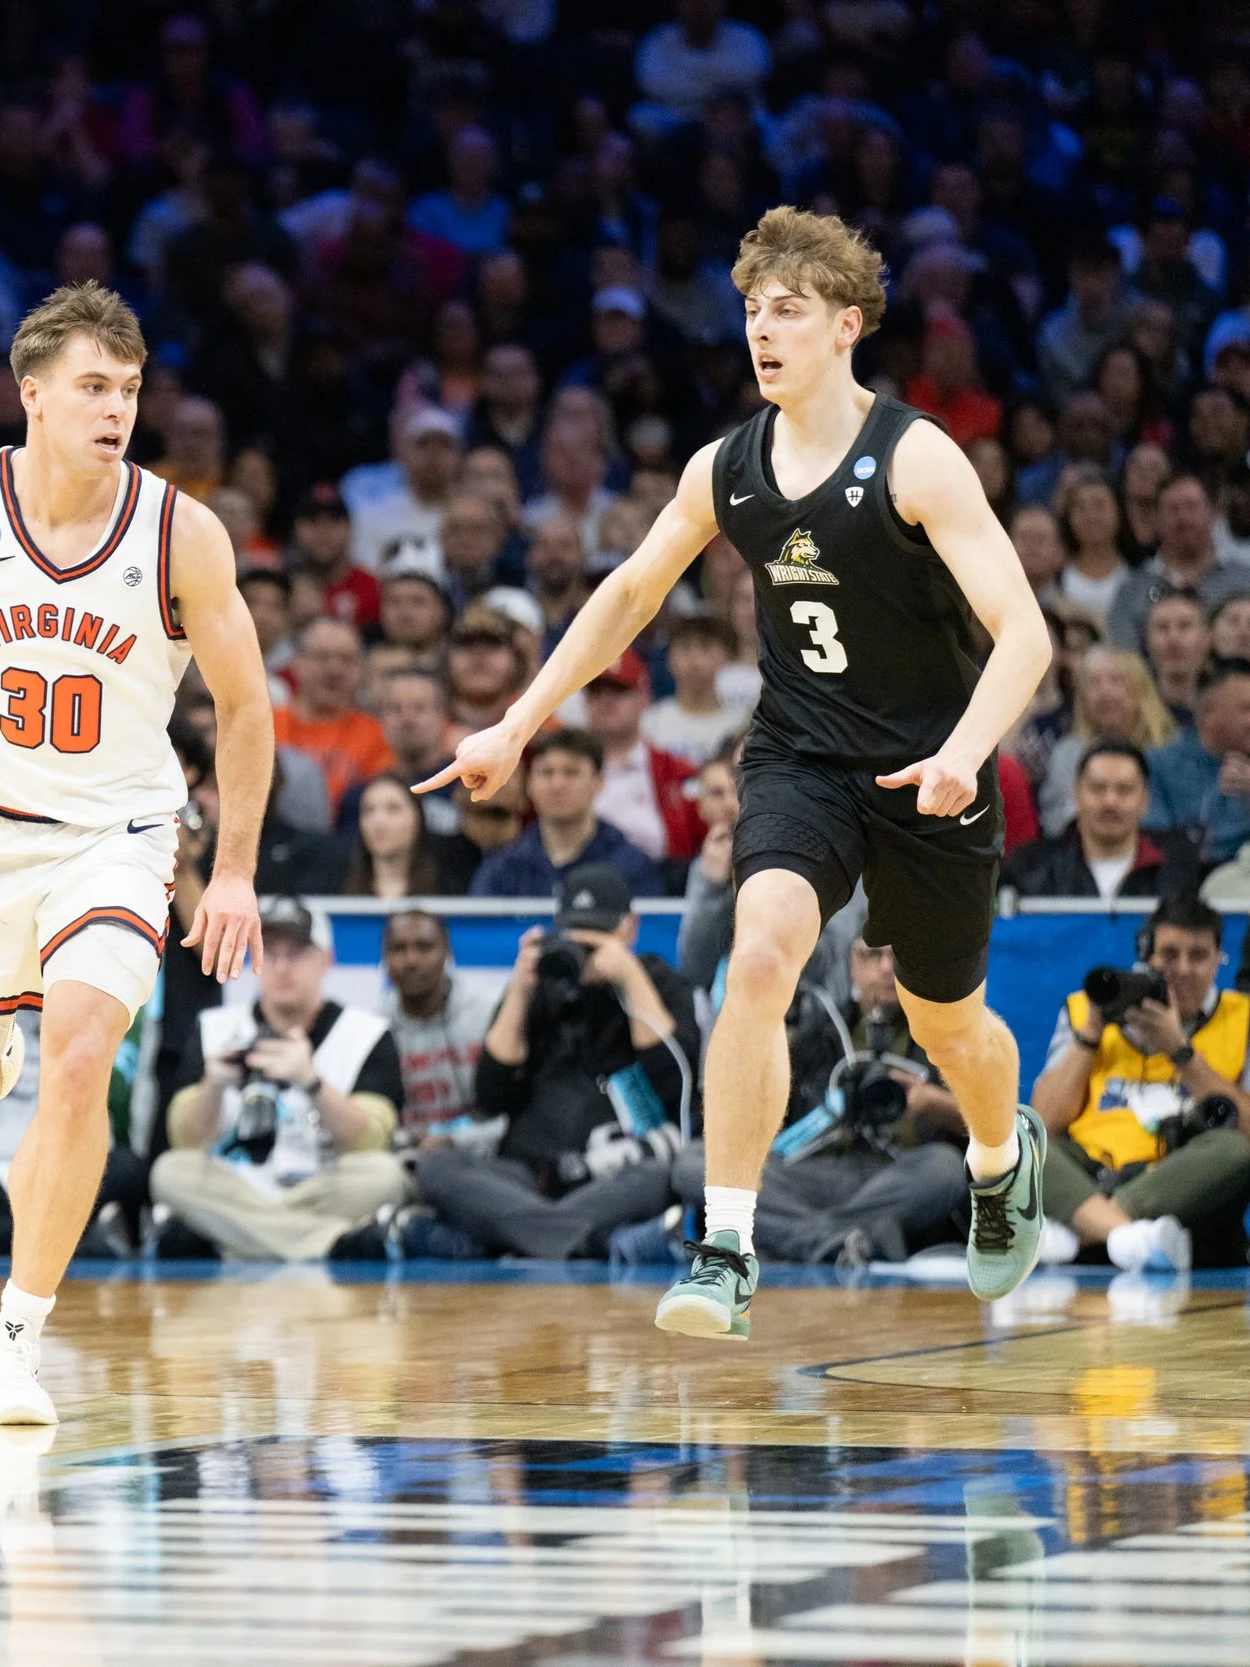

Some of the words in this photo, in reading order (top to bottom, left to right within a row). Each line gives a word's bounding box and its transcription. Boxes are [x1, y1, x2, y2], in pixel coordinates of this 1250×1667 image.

[769, 564, 810, 582] WRIGHT
[808, 569, 838, 583] STATE
[790, 600, 848, 674] 3
[0, 666, 103, 753] 30
